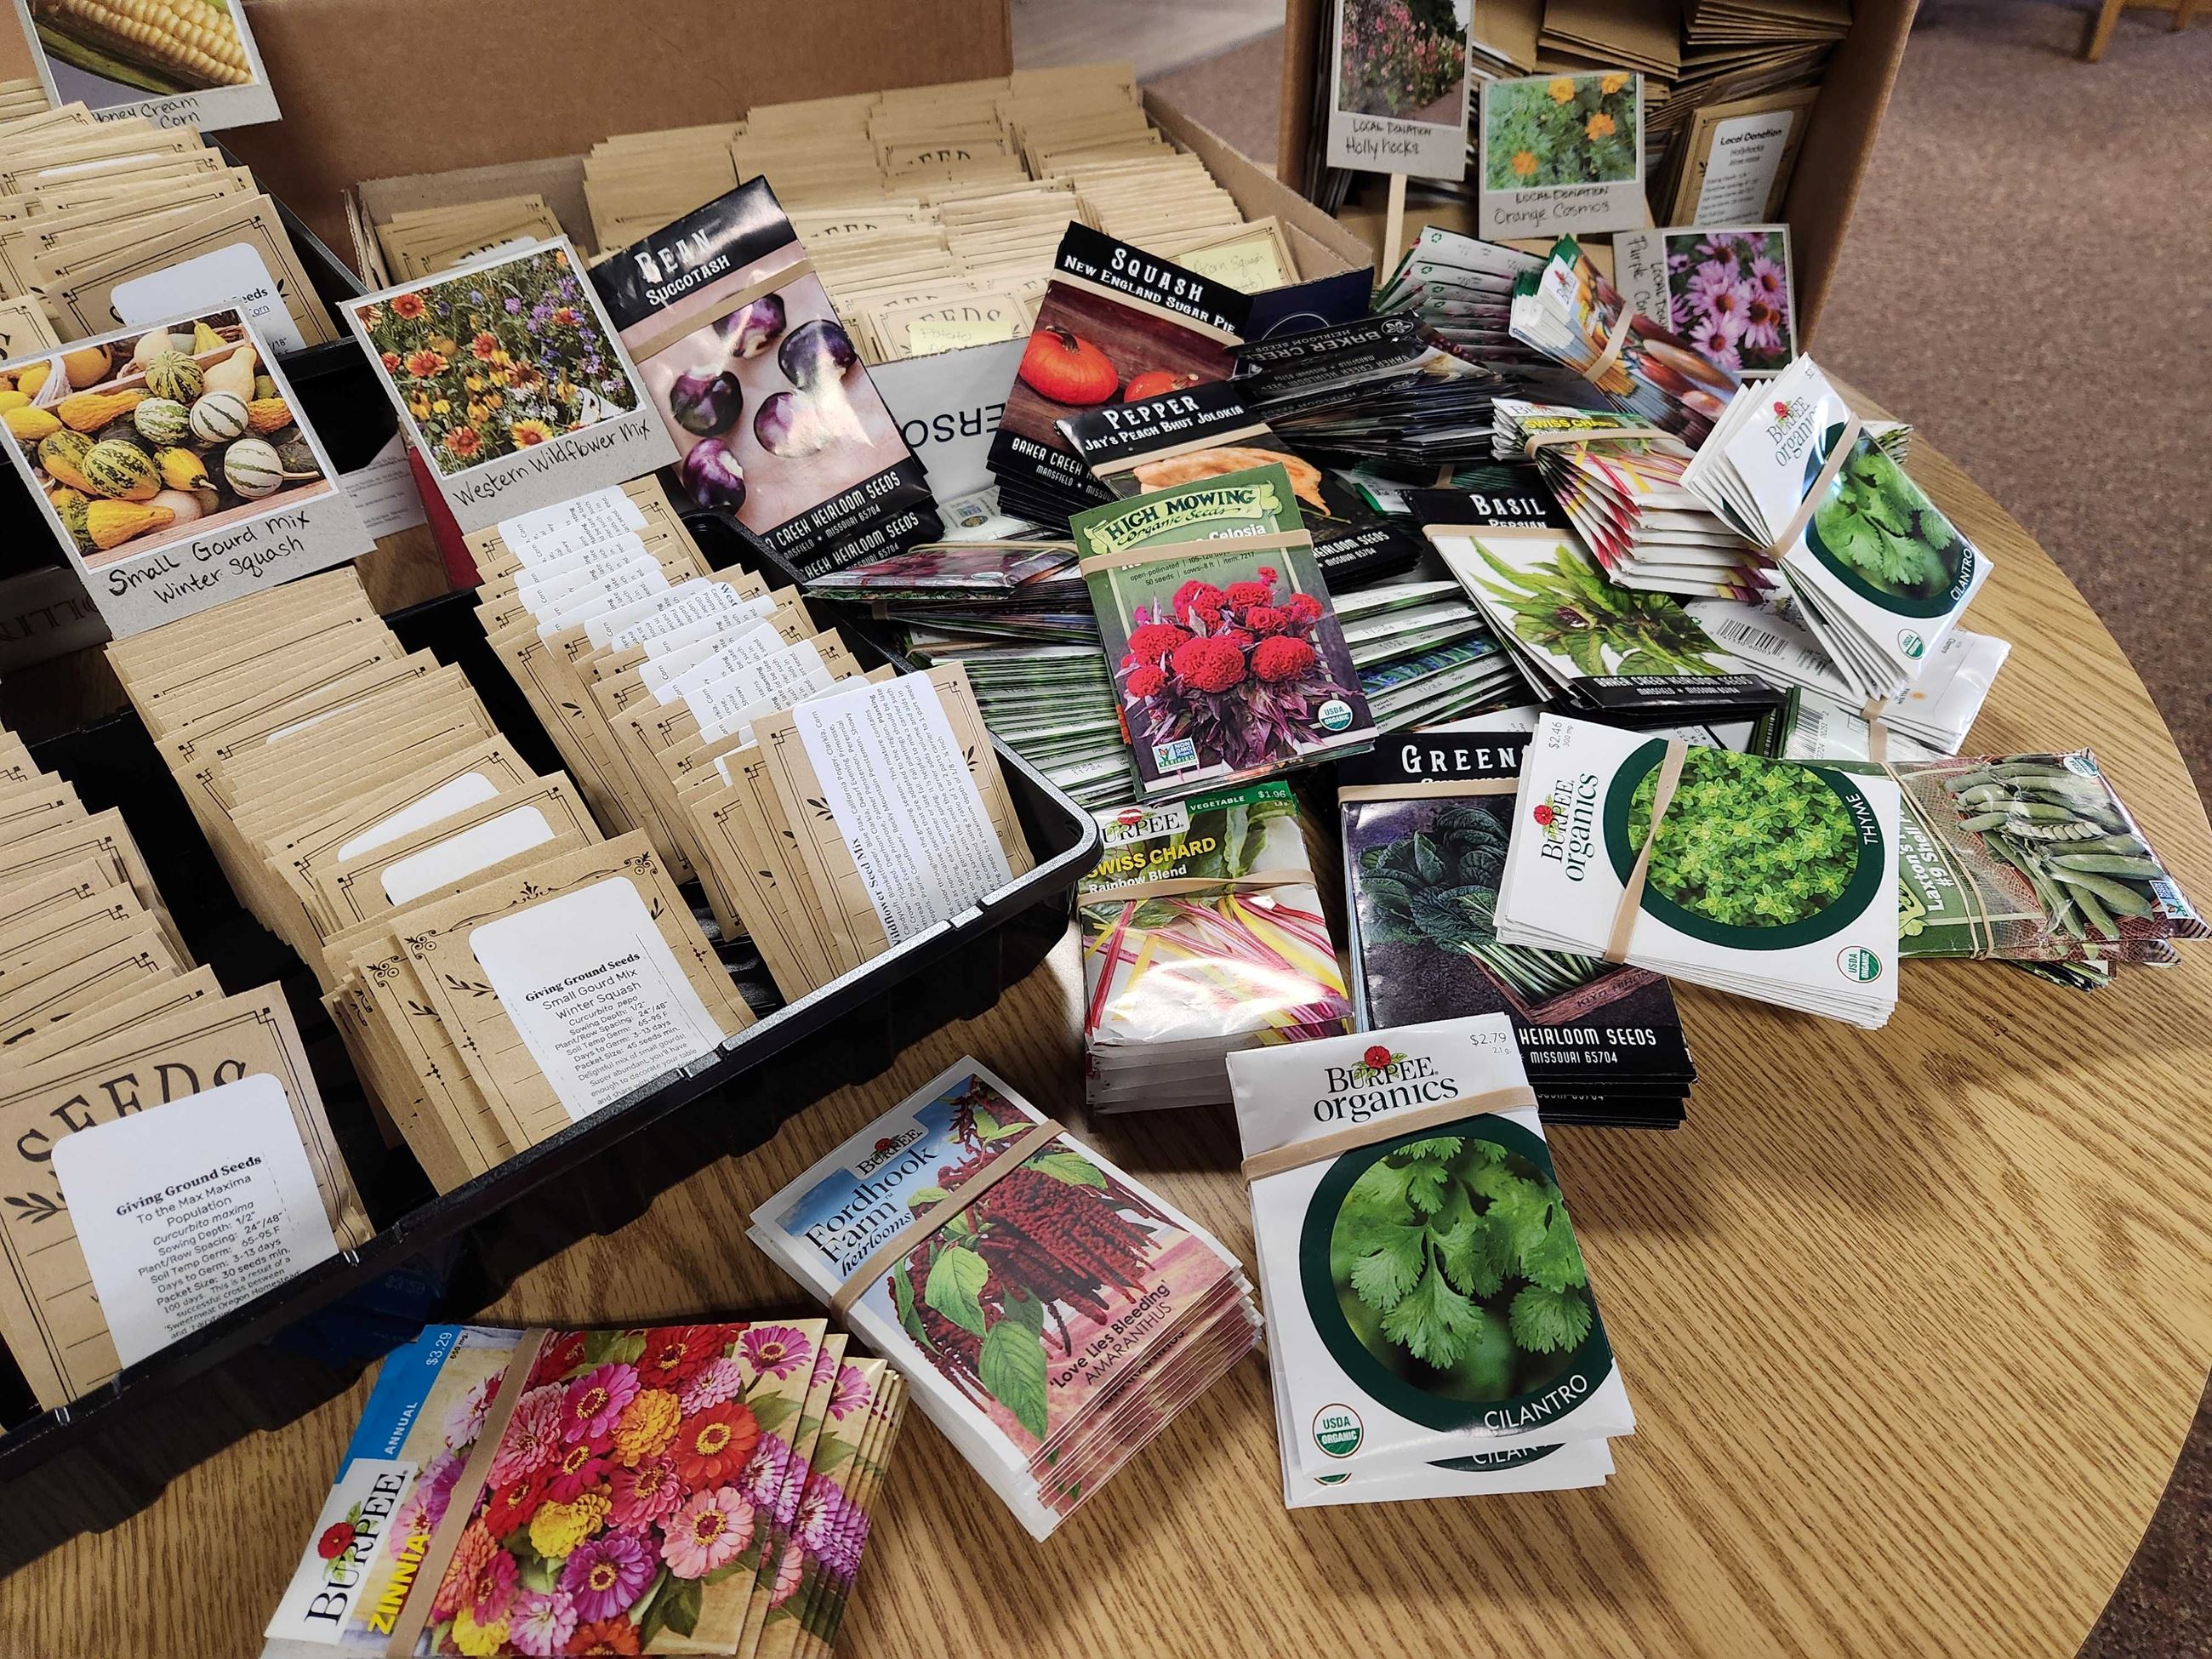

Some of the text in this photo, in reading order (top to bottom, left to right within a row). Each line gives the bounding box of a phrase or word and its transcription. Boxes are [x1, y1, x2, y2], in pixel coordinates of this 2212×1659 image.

[140, 96, 200, 118] Cream
[160, 111, 201, 129] Corn
[1494, 208, 1548, 228] Orange
[633, 228, 713, 284] BEAN
[645, 254, 731, 305] SUCCOTASH
[1063, 254, 1236, 335] NEW ENGLAND SUGAR PIE
[1111, 248, 1204, 303] SQUASH
[1309, 330, 1381, 351] BAKER
[1103, 395, 1200, 430] PEPPER
[1121, 425, 1160, 443] PEACH
[1163, 417, 1195, 434] BHUT
[1198, 404, 1245, 424] JOLOKIA
[1765, 396, 1810, 446] BURPEE
[453, 466, 531, 508] Western
[528, 431, 616, 473] Wildflower
[1012, 437, 1083, 476] BAKER CREEK
[1036, 465, 1074, 487] MANSFIELD
[776, 470, 902, 547] CREEK HEIRLOOM SEEDS
[1104, 488, 1256, 542] HIGH MOWING
[1468, 493, 1547, 516] BASIL
[783, 504, 882, 562] ANSFIELD MISSOURI 65704
[832, 528, 886, 566] HEIRLOOM
[886, 512, 920, 539] SEEDS
[1116, 505, 1226, 546] Organic Seeds
[1209, 523, 1267, 540] Celosia
[1360, 530, 1391, 547] SEEDS
[109, 554, 180, 596] Small
[192, 525, 258, 562] Gourd
[1130, 562, 1180, 582] open-pollinated
[1154, 573, 1175, 584] seeds
[1240, 550, 1255, 561] 7217
[1949, 547, 1974, 603] CILANTRO
[154, 569, 223, 604] Winter
[811, 710, 823, 728] Corn
[1324, 705, 1344, 715] USDA
[1324, 714, 1350, 726] ORGANIC
[1548, 721, 1563, 750] $2.46
[830, 755, 844, 780] Poppy,
[841, 781, 858, 814] California
[1190, 790, 1286, 811] VEGETABLE $1.96
[862, 831, 873, 847] Blue
[1101, 811, 1183, 844] URPEE
[1541, 779, 1574, 864] BURPEE
[1565, 772, 1599, 882] organics
[1844, 793, 1879, 847] THYME
[852, 837, 878, 887] Seed Mix
[1149, 837, 1217, 863] CHARD
[1916, 828, 1939, 866] Shell
[1088, 864, 1188, 894] Rainbow Blend
[1899, 841, 1946, 912] Laxton's
[525, 953, 640, 1001] Giving Ground Seeds
[1847, 952, 1857, 974] USDA
[1858, 952, 1871, 979] ORGANIC
[542, 968, 637, 1010] Small Gourd Mix
[555, 982, 641, 1019] Winter Squash
[616, 995, 638, 1008] pepo
[568, 1009, 628, 1035] Sowing Depth:
[1469, 1032, 1507, 1046] $2.79
[1519, 1028, 1656, 1046] HEIRLOOM SEEDS
[574, 1026, 681, 1071] Packet Size: 45 seeds min.
[1531, 1051, 1618, 1063] MISSOURI 65704
[1325, 1057, 1438, 1094] BURPEE
[1314, 1077, 1459, 1124] organics
[856, 1128, 923, 1177] BURPEE
[116, 1156, 261, 1215] Giving Ground Seeds
[135, 1175, 251, 1223] To the Max Maxima
[804, 1143, 938, 1251] Fordhook
[166, 1196, 231, 1227] Population
[211, 1200, 254, 1223] maxima
[157, 1236, 197, 1256] Sowing
[197, 1223, 231, 1240] Depth:
[822, 1200, 898, 1266] Farm
[841, 1210, 913, 1277] heirlooms
[138, 1232, 237, 1276] Plant/Row Spacing:
[157, 1238, 281, 1293] Days Germ: 3-13 days
[156, 1247, 290, 1305] Packet Size: 30 seeds min.
[1085, 1332, 1110, 1365] Lies
[1109, 1278, 1169, 1343] Bleeding'
[425, 1332, 453, 1365] $3.29
[450, 1346, 460, 1360] 650
[1085, 1303, 1172, 1386] AMARANTHUS
[1322, 1416, 1351, 1429] USDA
[1483, 1373, 1588, 1434] CILANTRO
[384, 1401, 417, 1456] ANNUAL
[1320, 1431, 1358, 1445] ORGANIC
[305, 1472, 404, 1624] BURPEE
[368, 1532, 429, 1633] ZINNIA
